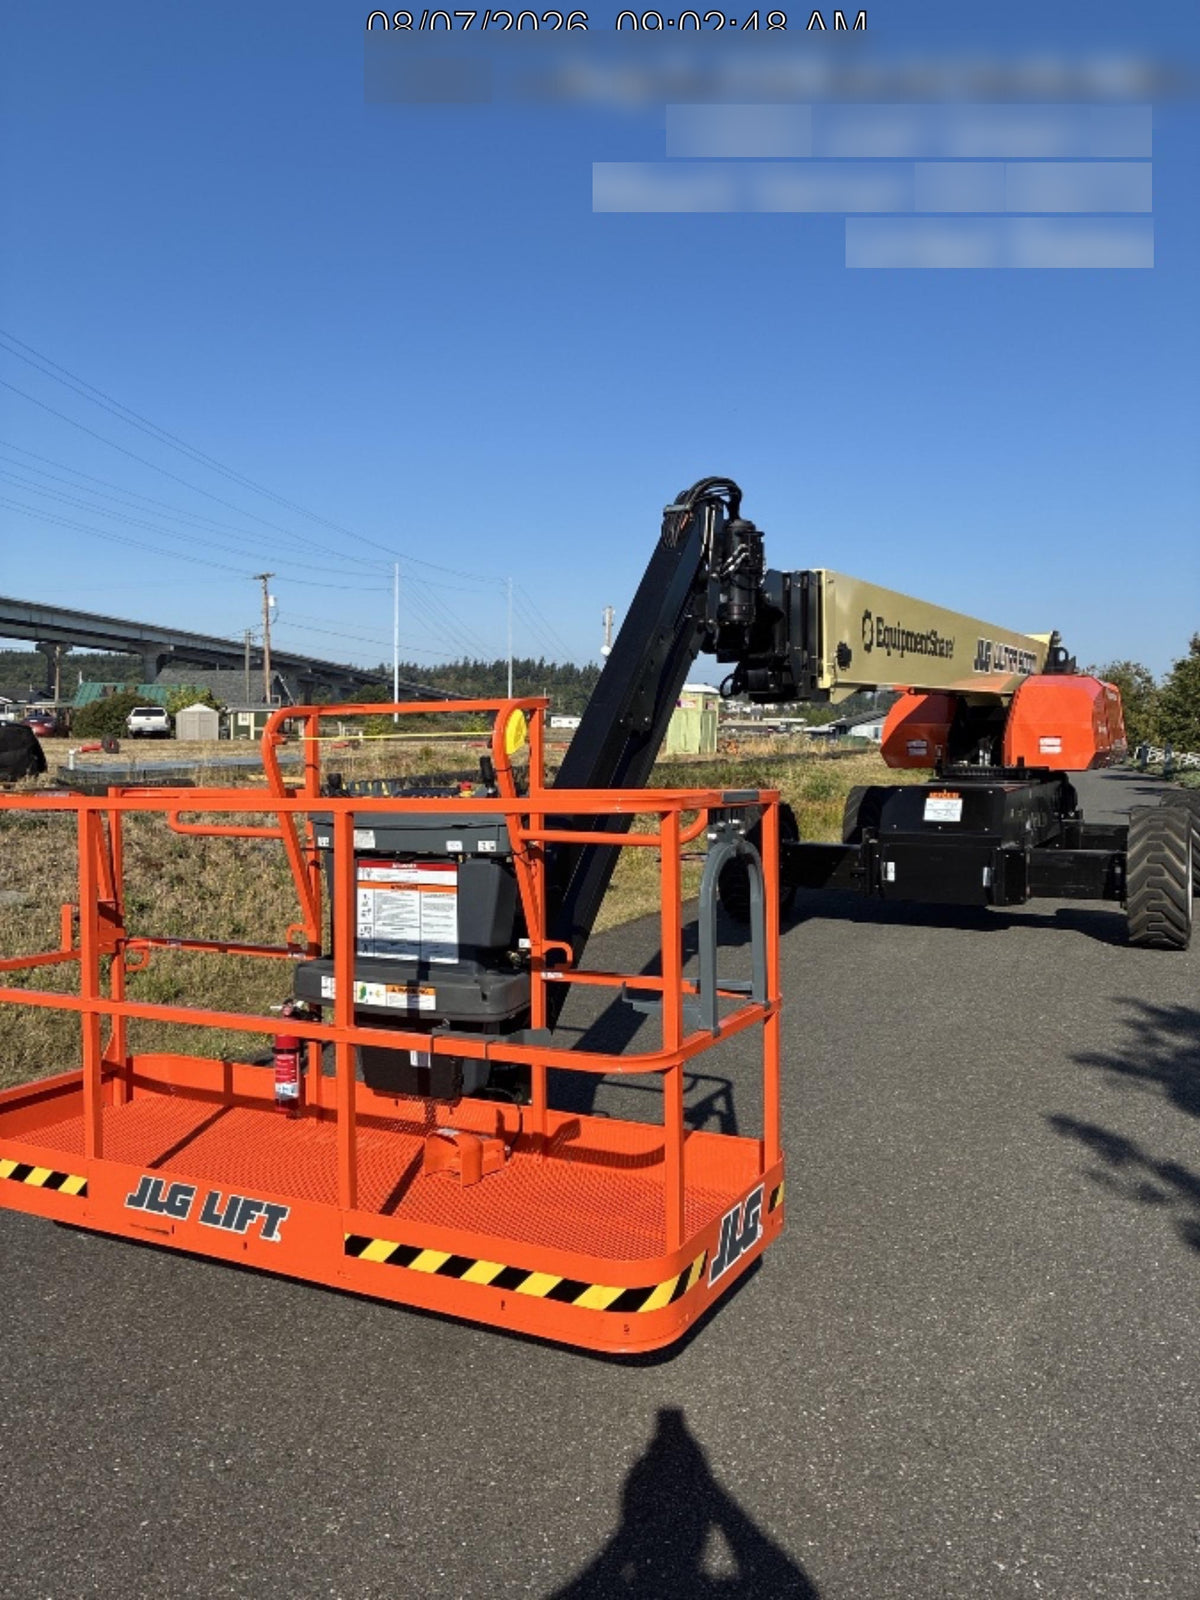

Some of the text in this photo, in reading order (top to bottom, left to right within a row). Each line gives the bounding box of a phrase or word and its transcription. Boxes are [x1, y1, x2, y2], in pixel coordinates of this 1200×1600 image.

[875, 615, 955, 660] EquipmentShare
[124, 1174, 291, 1242] JLG LIFT
[707, 1182, 765, 1289] JLG
